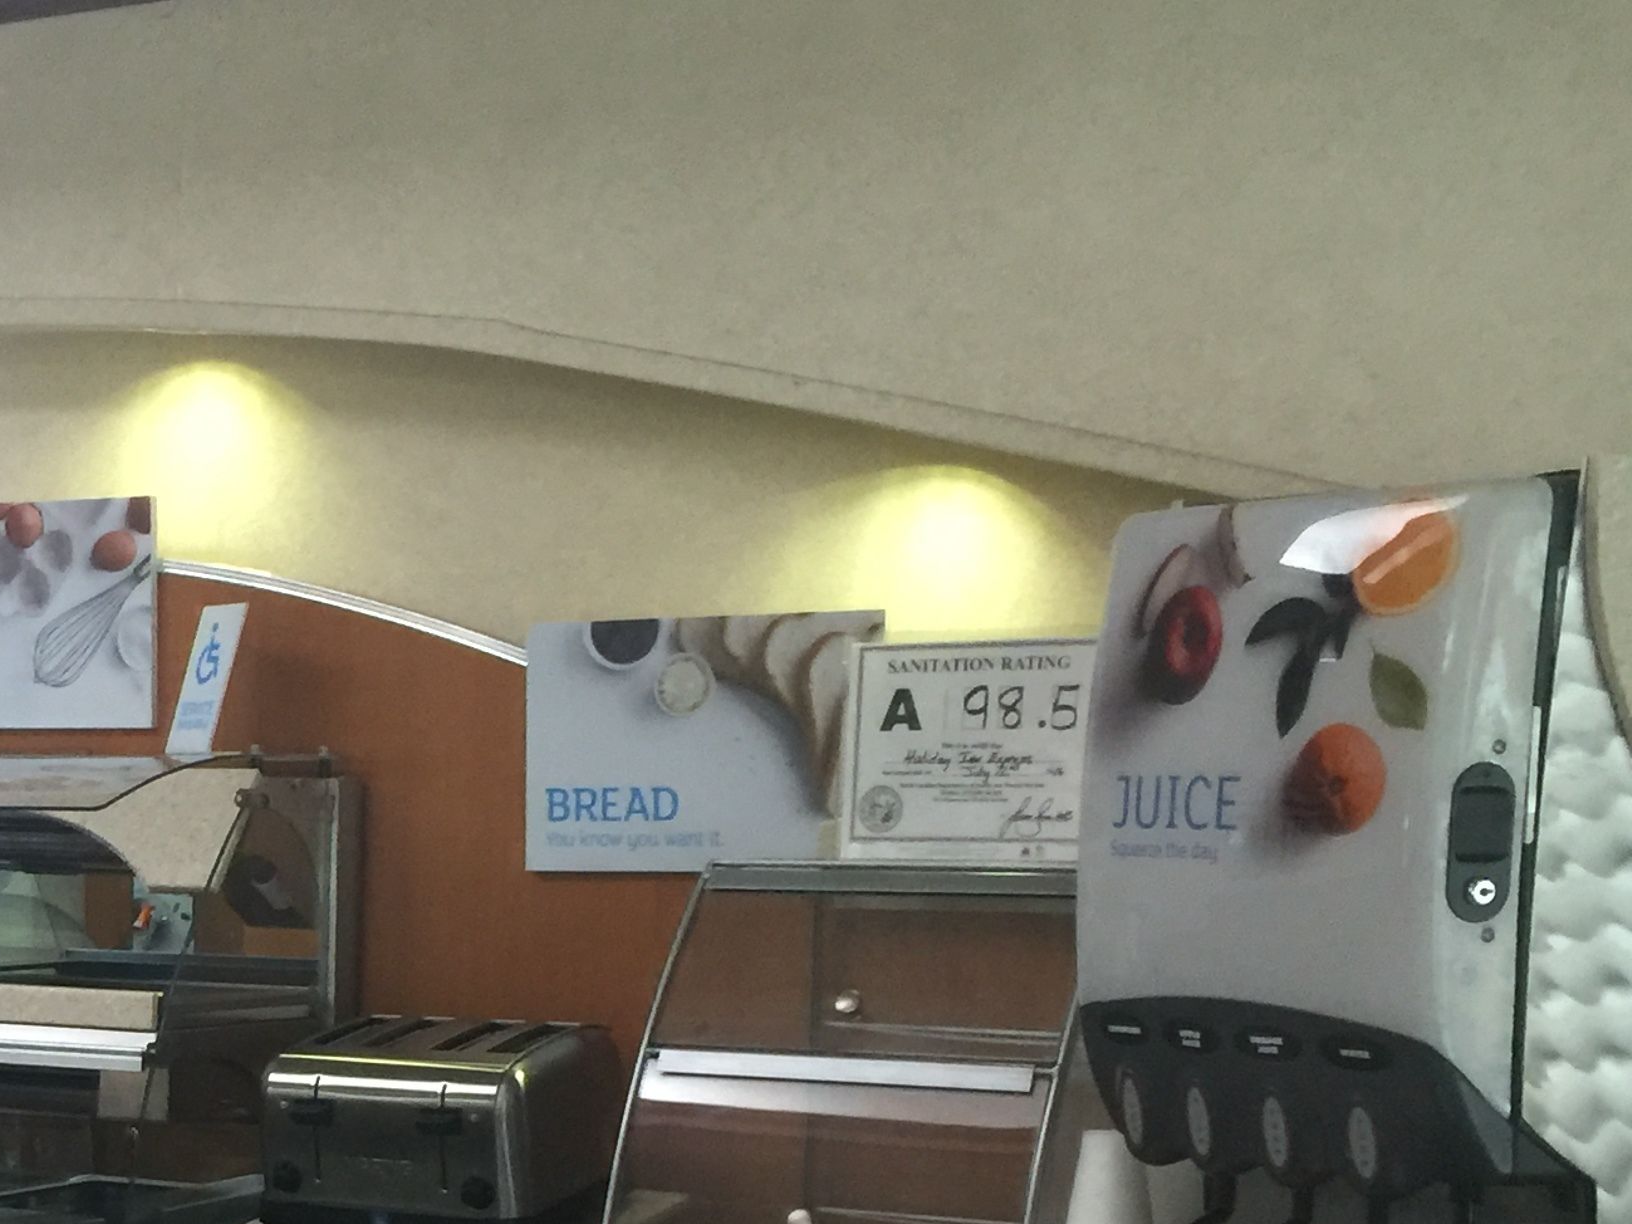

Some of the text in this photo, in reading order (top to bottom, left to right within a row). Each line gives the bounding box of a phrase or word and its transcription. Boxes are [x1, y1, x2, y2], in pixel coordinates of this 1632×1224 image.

[887, 655, 1073, 674] SANITATION RATING
[879, 684, 1081, 732] A 98.5
[545, 786, 680, 822] BREAD
[1112, 774, 1242, 831] JUICE
[546, 832, 575, 847] You
[579, 830, 622, 847] know
[627, 833, 660, 852] you
[665, 832, 705, 848] want
